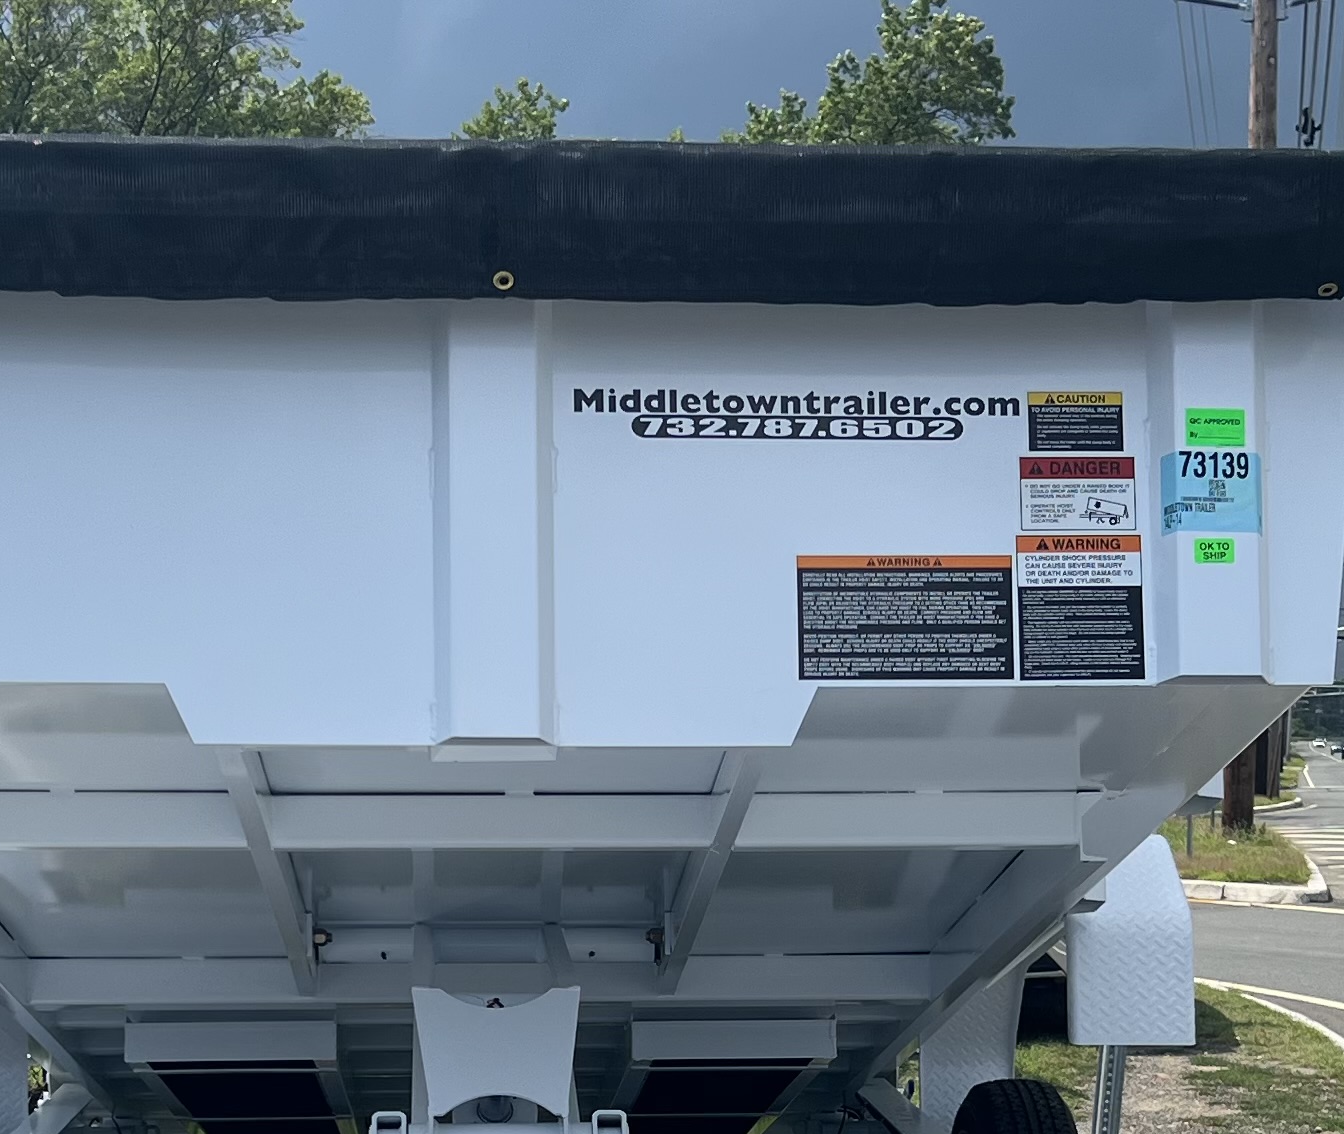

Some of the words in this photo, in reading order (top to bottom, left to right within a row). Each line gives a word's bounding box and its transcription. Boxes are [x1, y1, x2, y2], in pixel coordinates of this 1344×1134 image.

[573, 388, 1020, 417] Middletowntrailer.com
[1055, 394, 1106, 404] CAUTION
[1189, 417, 1201, 426] QC
[1203, 417, 1241, 426] APPROVED
[638, 418, 955, 438] 732.787.6502
[1049, 461, 1121, 475] DANGER
[1178, 450, 1250, 479] 73139
[1051, 538, 1121, 550] WARNING
[1199, 542, 1215, 551] OK
[1216, 542, 1230, 551] TO
[1202, 552, 1227, 560] SHIP
[876, 558, 931, 566] WARNING
